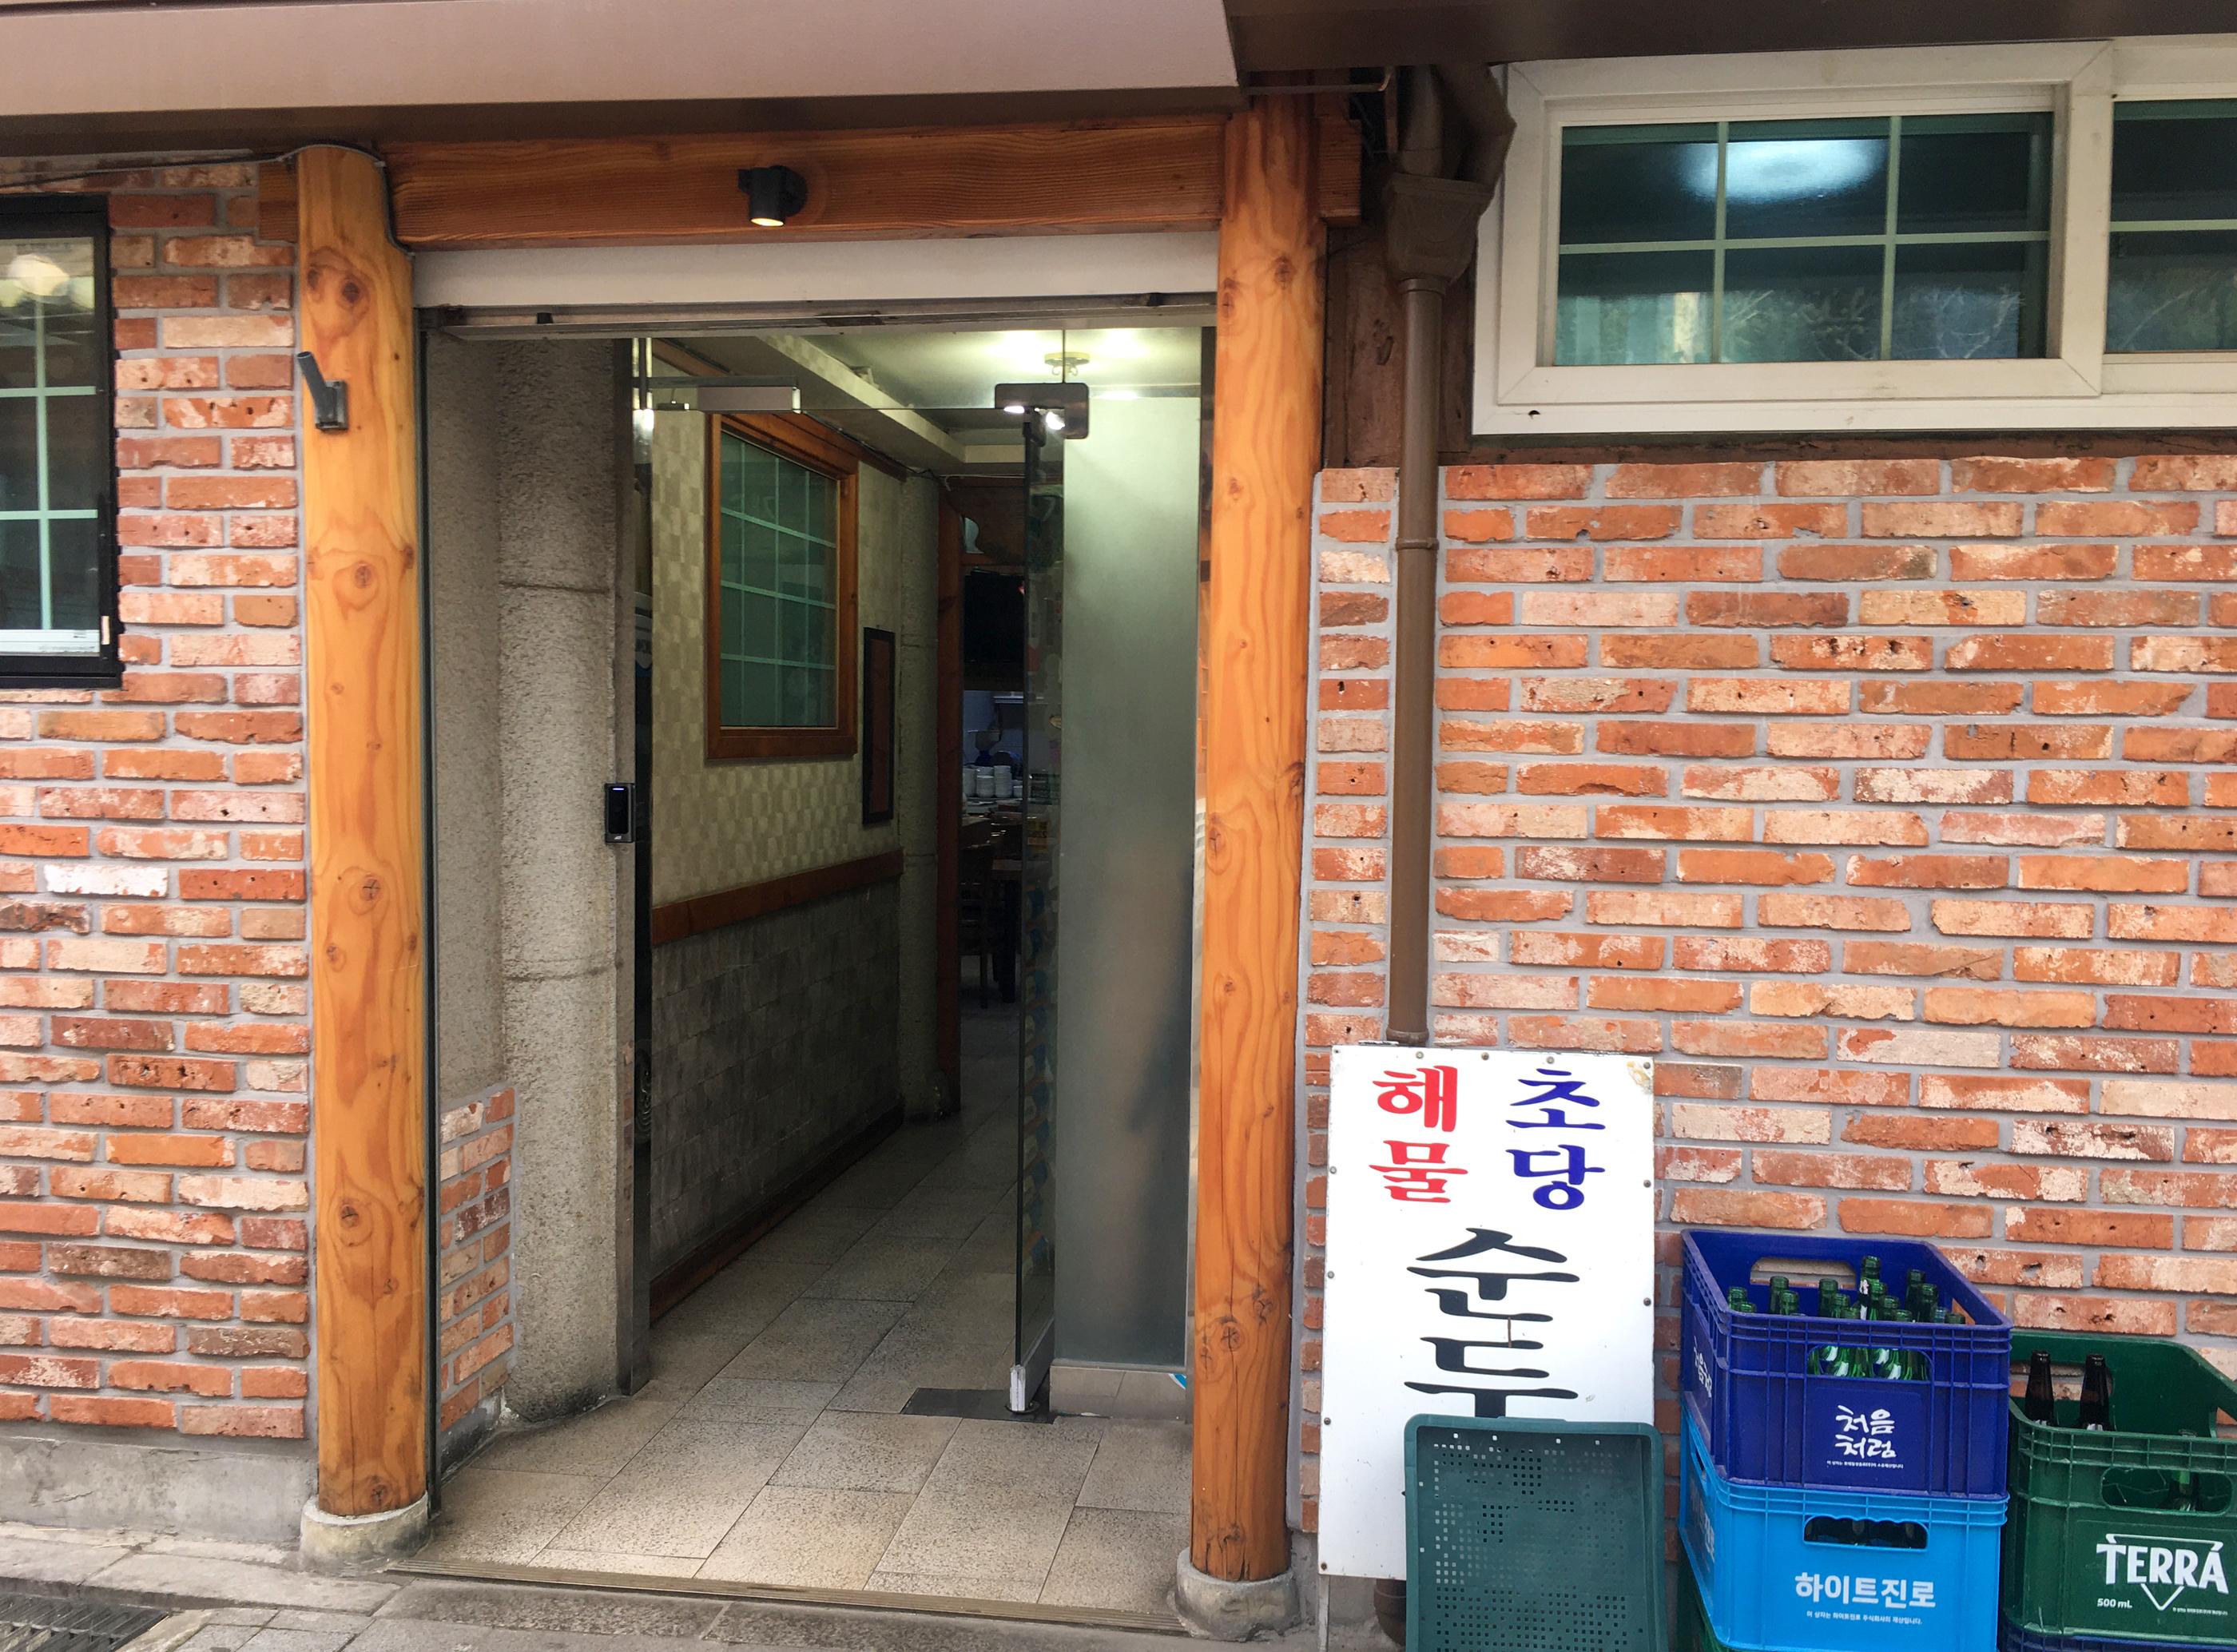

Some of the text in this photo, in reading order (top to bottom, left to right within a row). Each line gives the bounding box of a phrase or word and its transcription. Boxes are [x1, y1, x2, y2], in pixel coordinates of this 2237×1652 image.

[1369, 1065, 1468, 1204] 해물
[1505, 1067, 1606, 1210] 초당
[1404, 1227, 1580, 1419] 순두
[1835, 1404, 1896, 1435] 처음
[1834, 1435, 1897, 1459] 처럼
[1794, 1571, 1937, 1609] 하이트진로
[2096, 1543, 2229, 1595] TERRA
[2097, 1598, 2132, 1609] 500 mL
